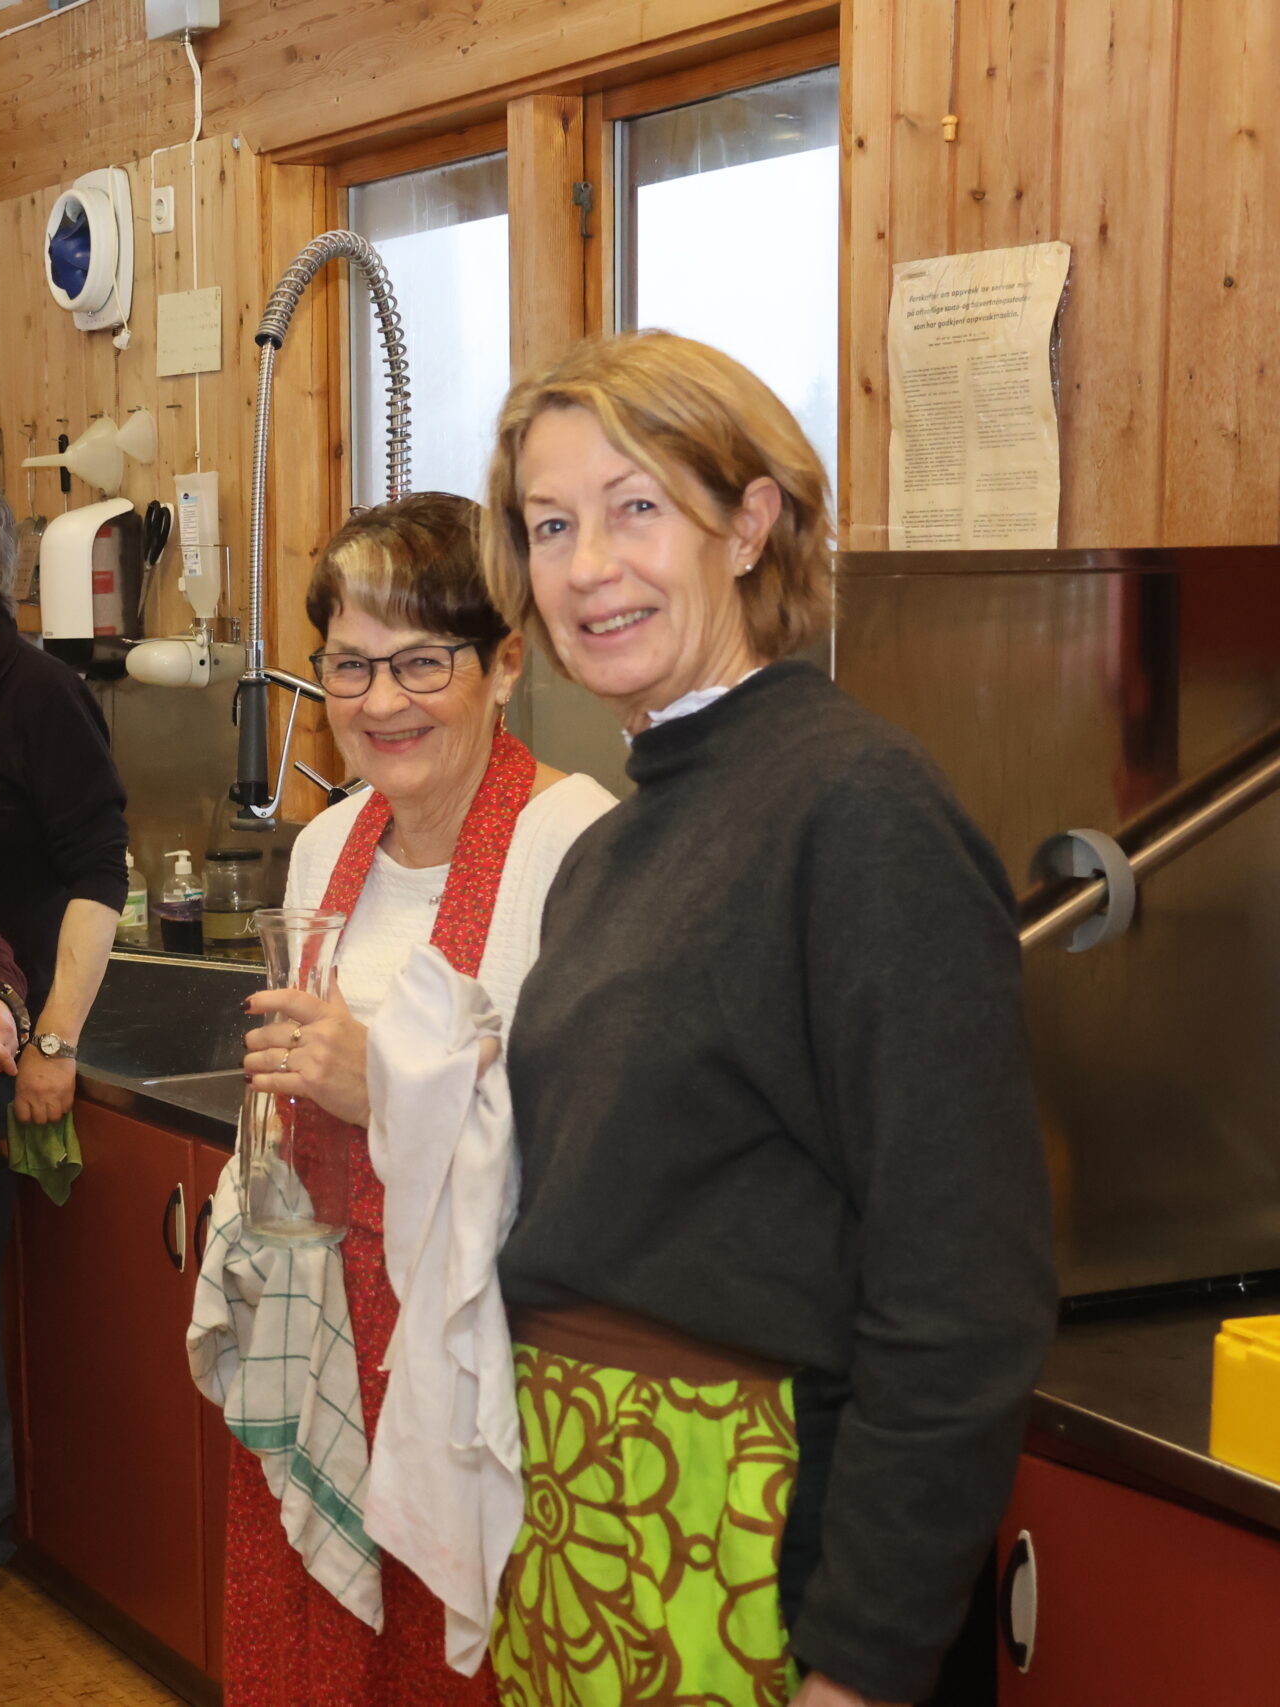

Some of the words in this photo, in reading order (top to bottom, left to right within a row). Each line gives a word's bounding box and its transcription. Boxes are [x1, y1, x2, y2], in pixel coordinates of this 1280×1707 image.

[951, 286, 979, 297] oppvask
[914, 323, 925, 331] som
[926, 321, 937, 329] har
[937, 316, 966, 329] godkjent
